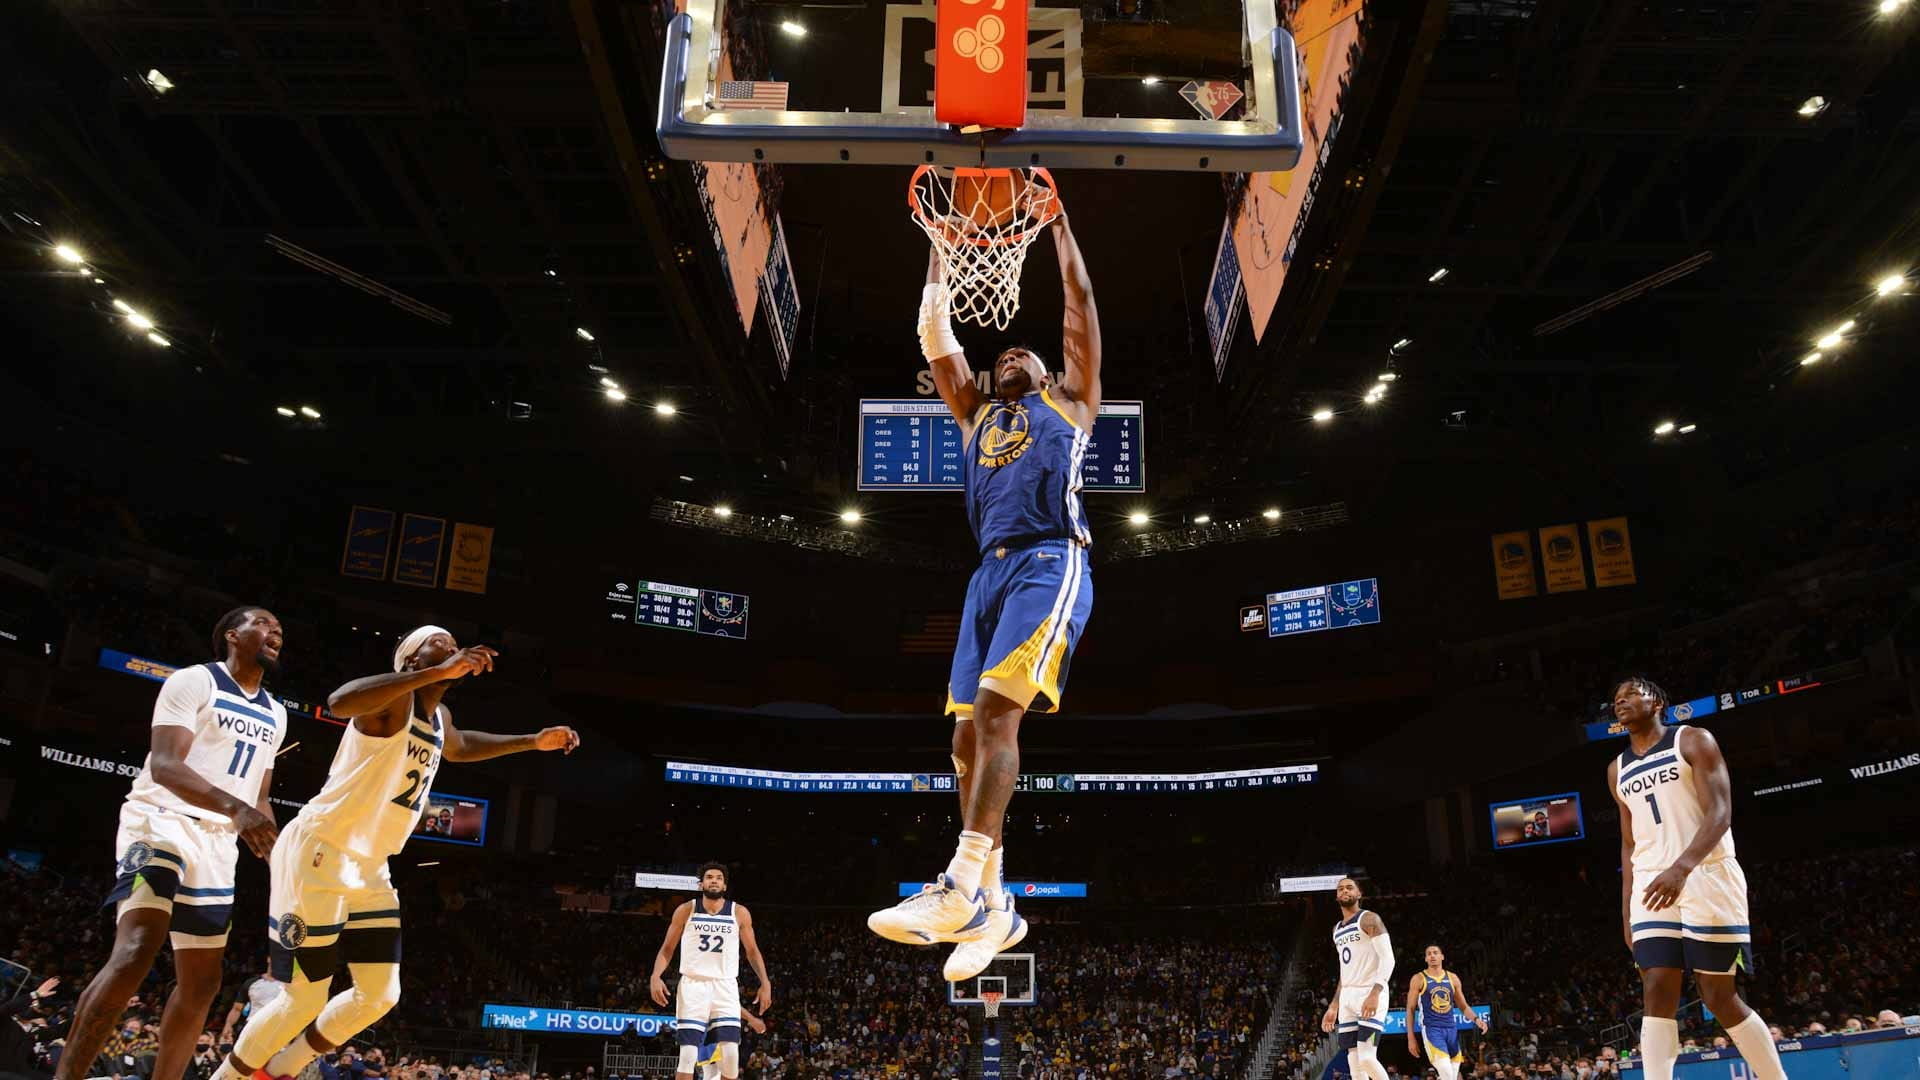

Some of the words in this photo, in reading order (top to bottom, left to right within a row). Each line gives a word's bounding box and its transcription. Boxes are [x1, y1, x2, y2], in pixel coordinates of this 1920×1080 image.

[1123, 419, 1129, 427] 4
[913, 452, 919, 460] 11
[979, 437, 1033, 468] WARRIORS
[1120, 453, 1129, 461] 38
[1113, 464, 1129, 473] 40.4
[1114, 476, 1130, 484] 75.0
[1742, 689, 1760, 699] TOR
[282, 700, 299, 710] TOR
[217, 713, 274, 745] WOLVES
[41, 746, 115, 773] WILLIAMS
[228, 739, 256, 779] 11
[1850, 753, 1920, 779] WILLIAMS
[933, 777, 951, 789] 105
[1035, 778, 1053, 789] 100
[1621, 767, 1680, 798] WOLVES
[1645, 793, 1662, 824] 1
[1037, 887, 1060, 895] pepsi
[694, 923, 732, 933] WOLVES
[698, 935, 724, 953] 32
[1342, 947, 1352, 964] 0
[546, 1013, 572, 1029] HR
